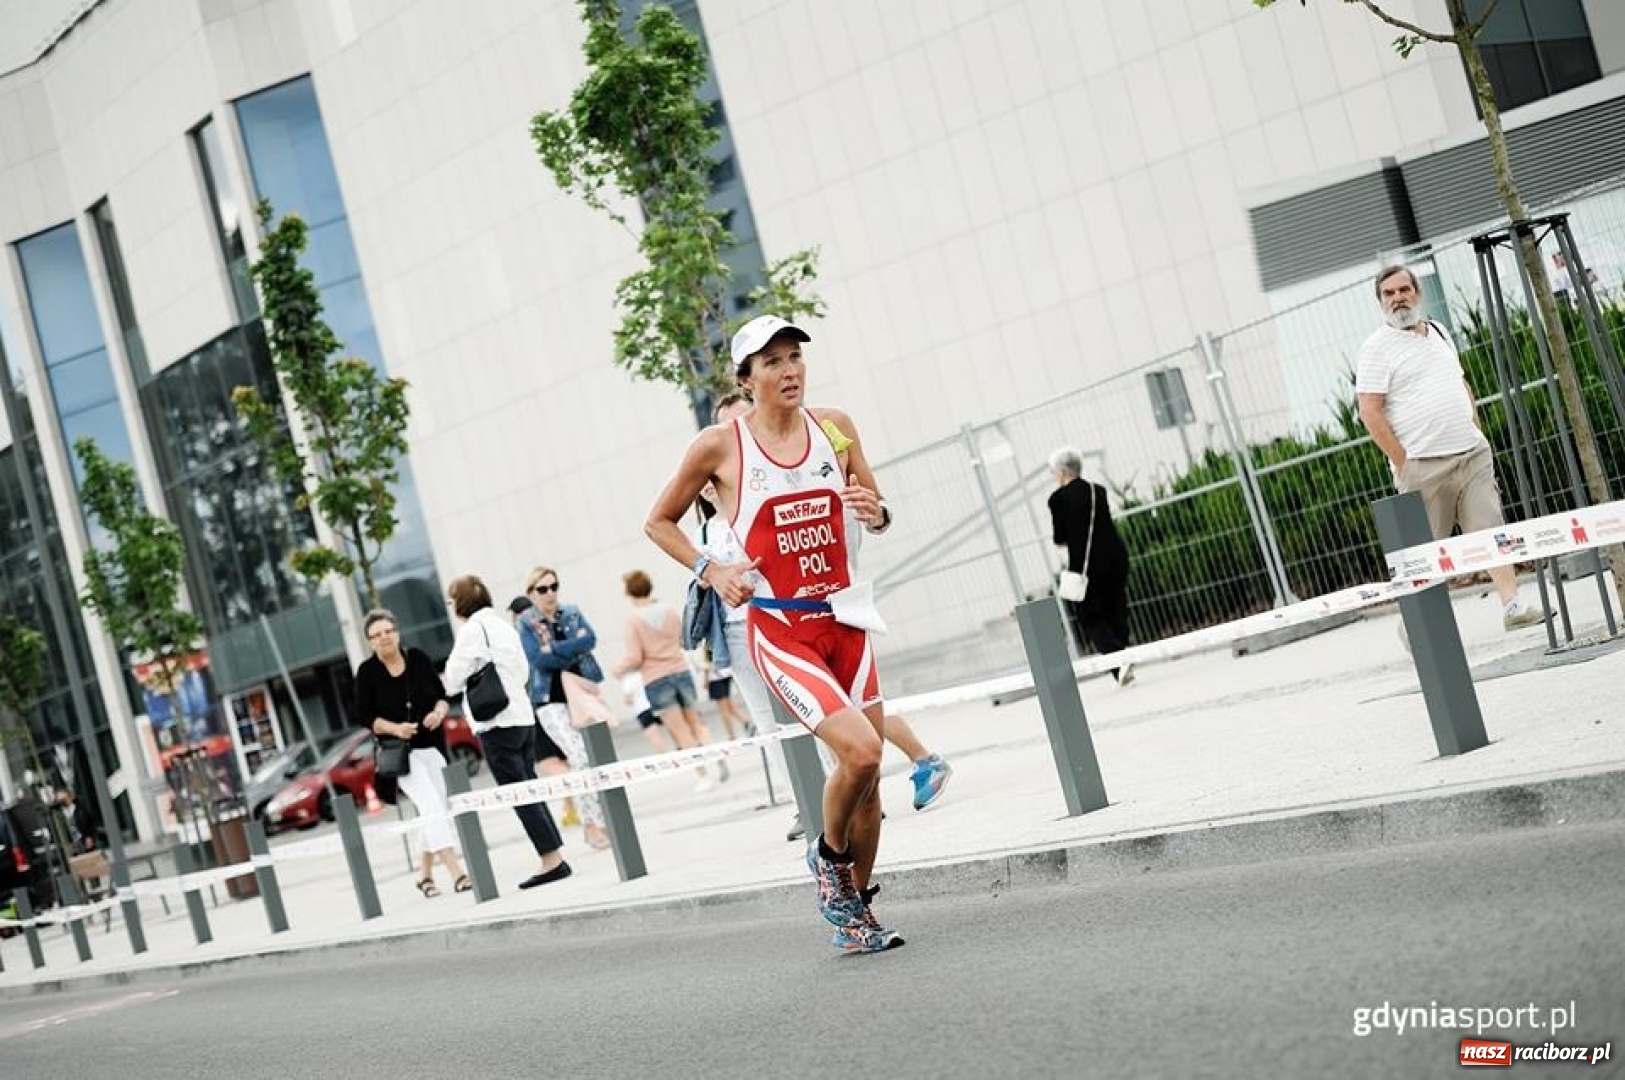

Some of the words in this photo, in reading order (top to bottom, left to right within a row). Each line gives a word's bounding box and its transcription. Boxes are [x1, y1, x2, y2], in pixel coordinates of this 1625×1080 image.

[776, 522, 837, 555] BUGDOL
[798, 551, 832, 578] POL
[776, 674, 814, 718] kiwami
